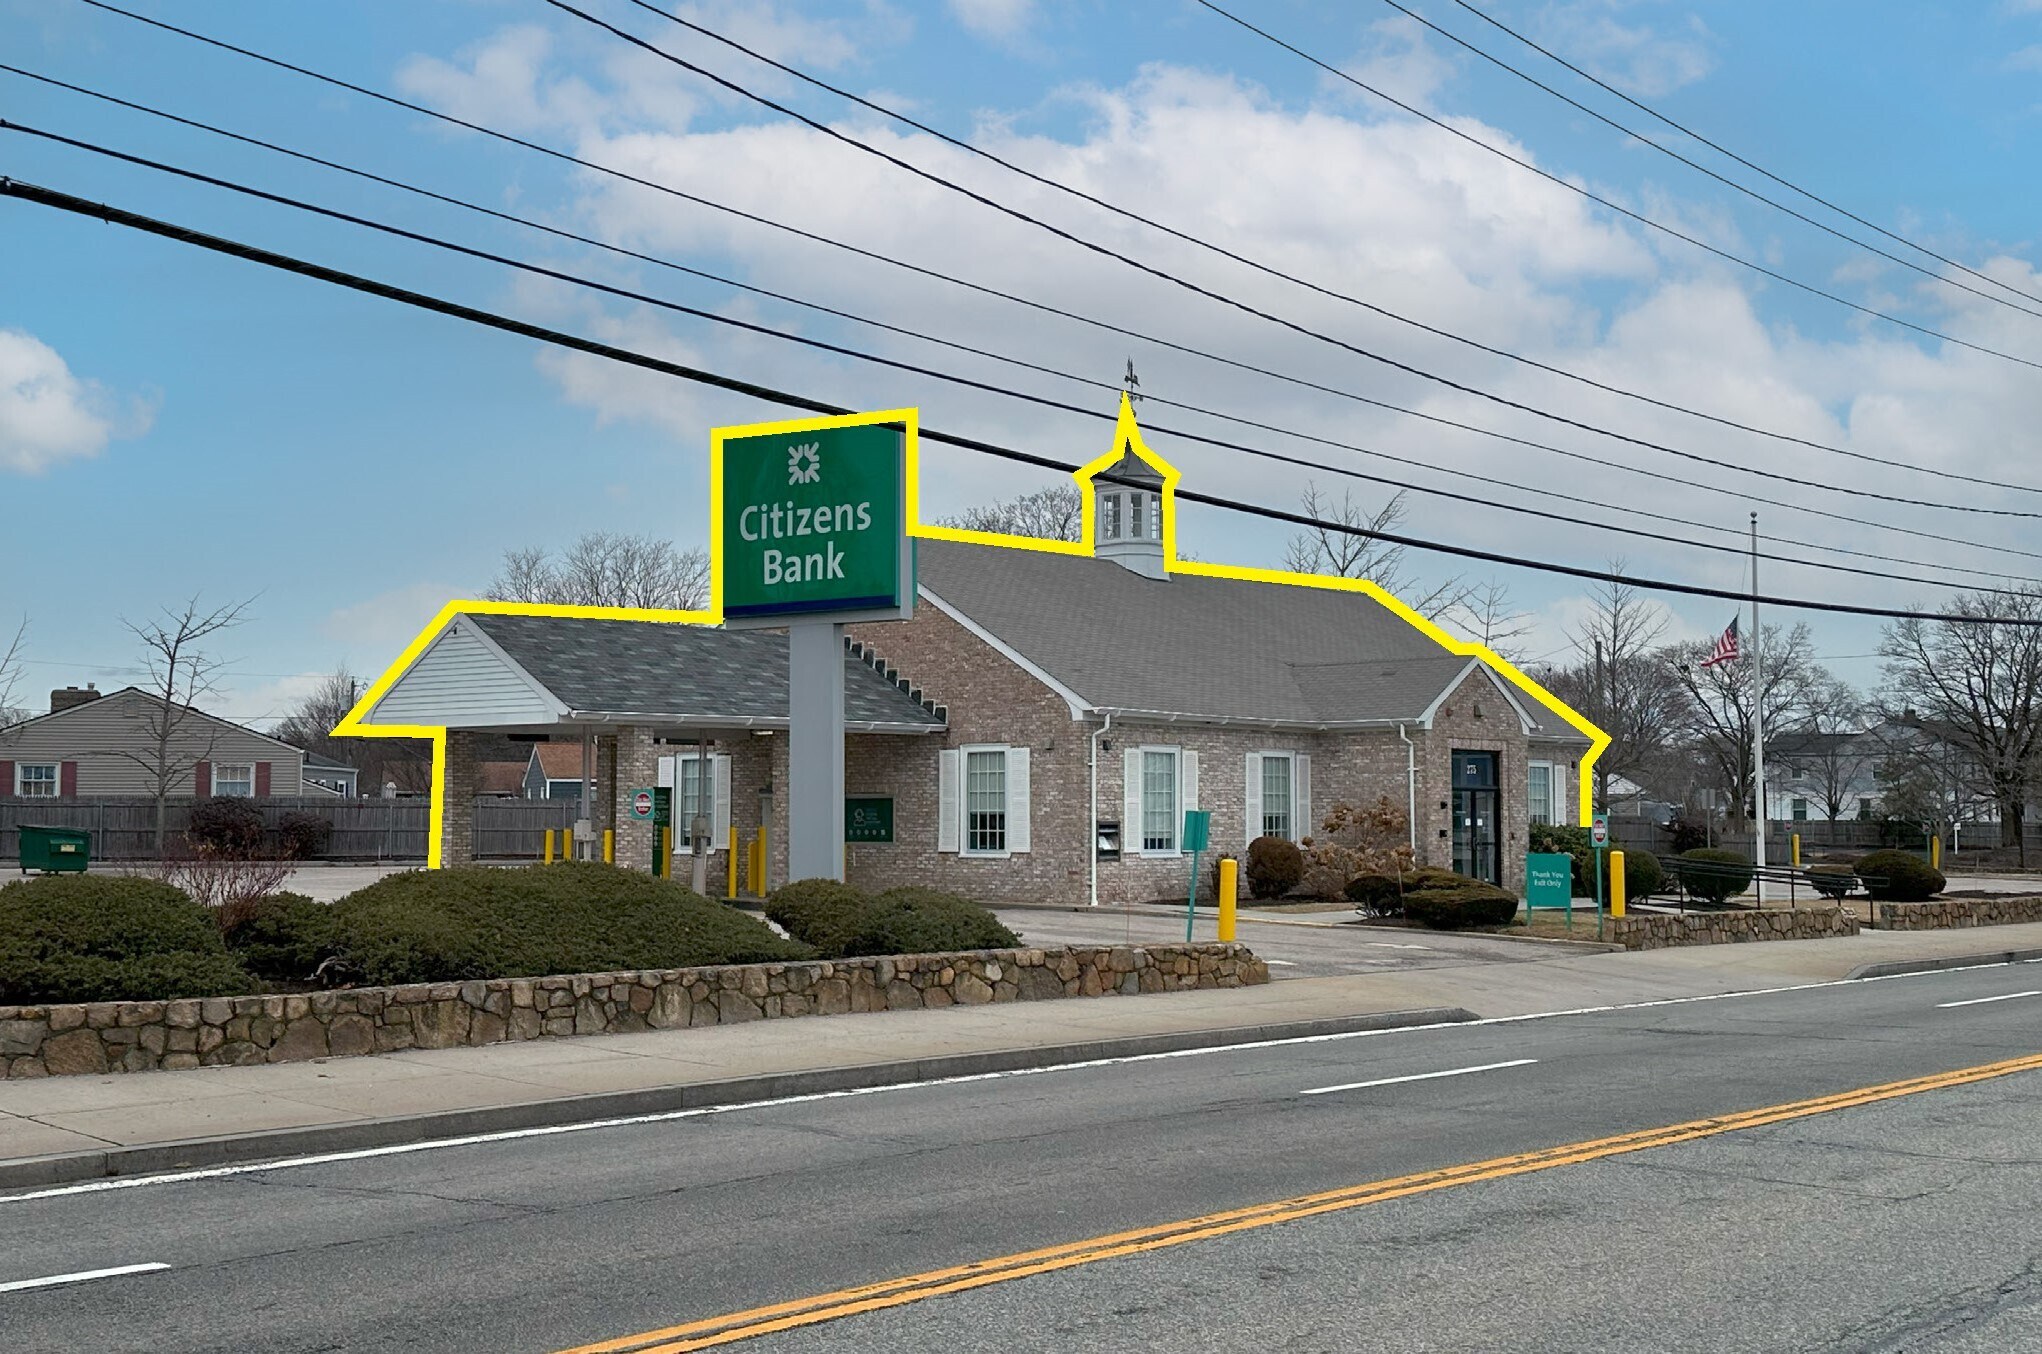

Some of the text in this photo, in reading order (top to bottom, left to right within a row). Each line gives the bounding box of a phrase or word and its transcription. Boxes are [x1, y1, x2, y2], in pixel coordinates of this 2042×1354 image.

[739, 500, 872, 541] Citizens
[763, 541, 845, 585] Bank
[1531, 870, 1564, 879] Thank You
[1534, 879, 1561, 889] Exit Only
